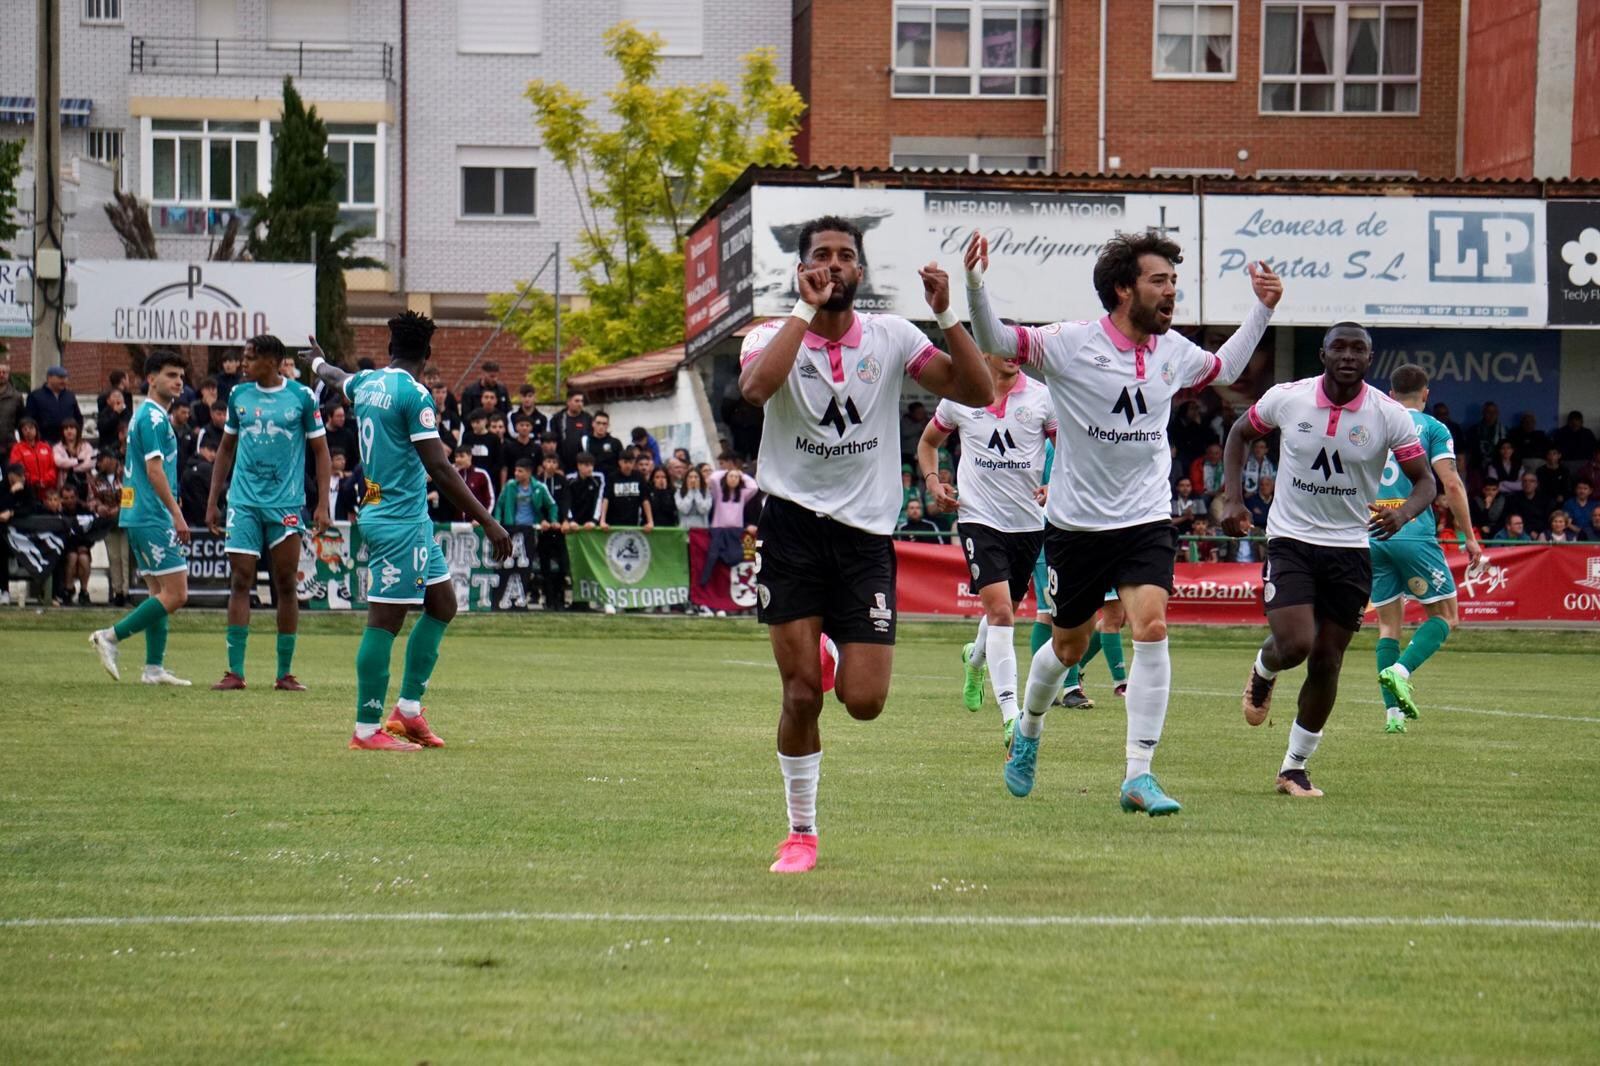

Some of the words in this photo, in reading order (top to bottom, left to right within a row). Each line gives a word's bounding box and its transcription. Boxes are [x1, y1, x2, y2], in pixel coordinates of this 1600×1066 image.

[928, 199, 1012, 217] FUNERARIA
[1030, 201, 1122, 219] TANATORIO
[1234, 207, 1347, 238] Leonesa
[1356, 211, 1389, 237] de
[1433, 216, 1530, 278] LP
[1343, 250, 1408, 282] S.L.
[1563, 289, 1588, 301] Tecly
[112, 307, 190, 340] CECINAS
[192, 310, 270, 342] PABLO
[1088, 425, 1162, 444] Medyarthros
[795, 436, 878, 459] Medyarthros
[975, 457, 1032, 471] Medyarthros
[1292, 477, 1358, 496] Medyarthros
[413, 546, 429, 572] 19
[1172, 580, 1257, 600] xaBank
